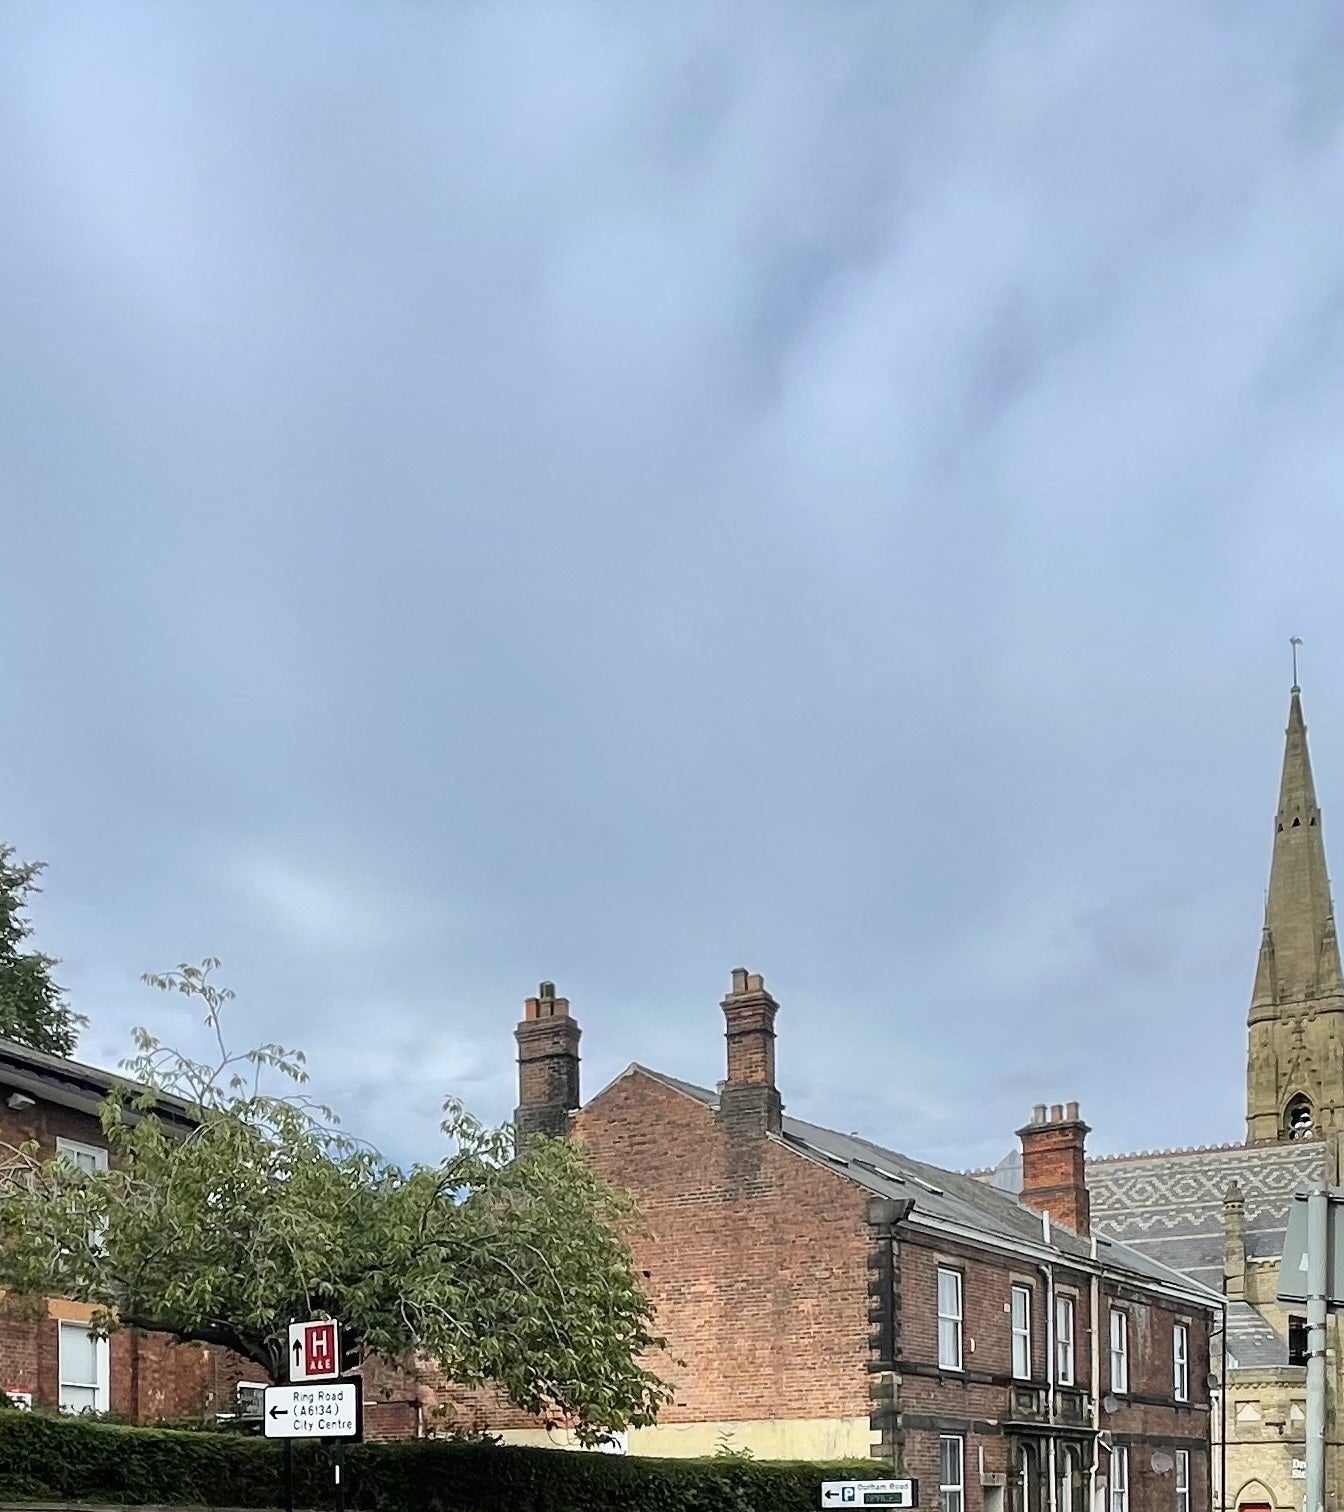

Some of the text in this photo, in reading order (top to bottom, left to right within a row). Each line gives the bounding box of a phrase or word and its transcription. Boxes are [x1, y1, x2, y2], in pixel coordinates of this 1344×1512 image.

[312, 1330, 327, 1357] H
[293, 1390, 344, 1403] Ring Road
[293, 1404, 339, 1416] (A6134)
[293, 1417, 352, 1432] City Centre
